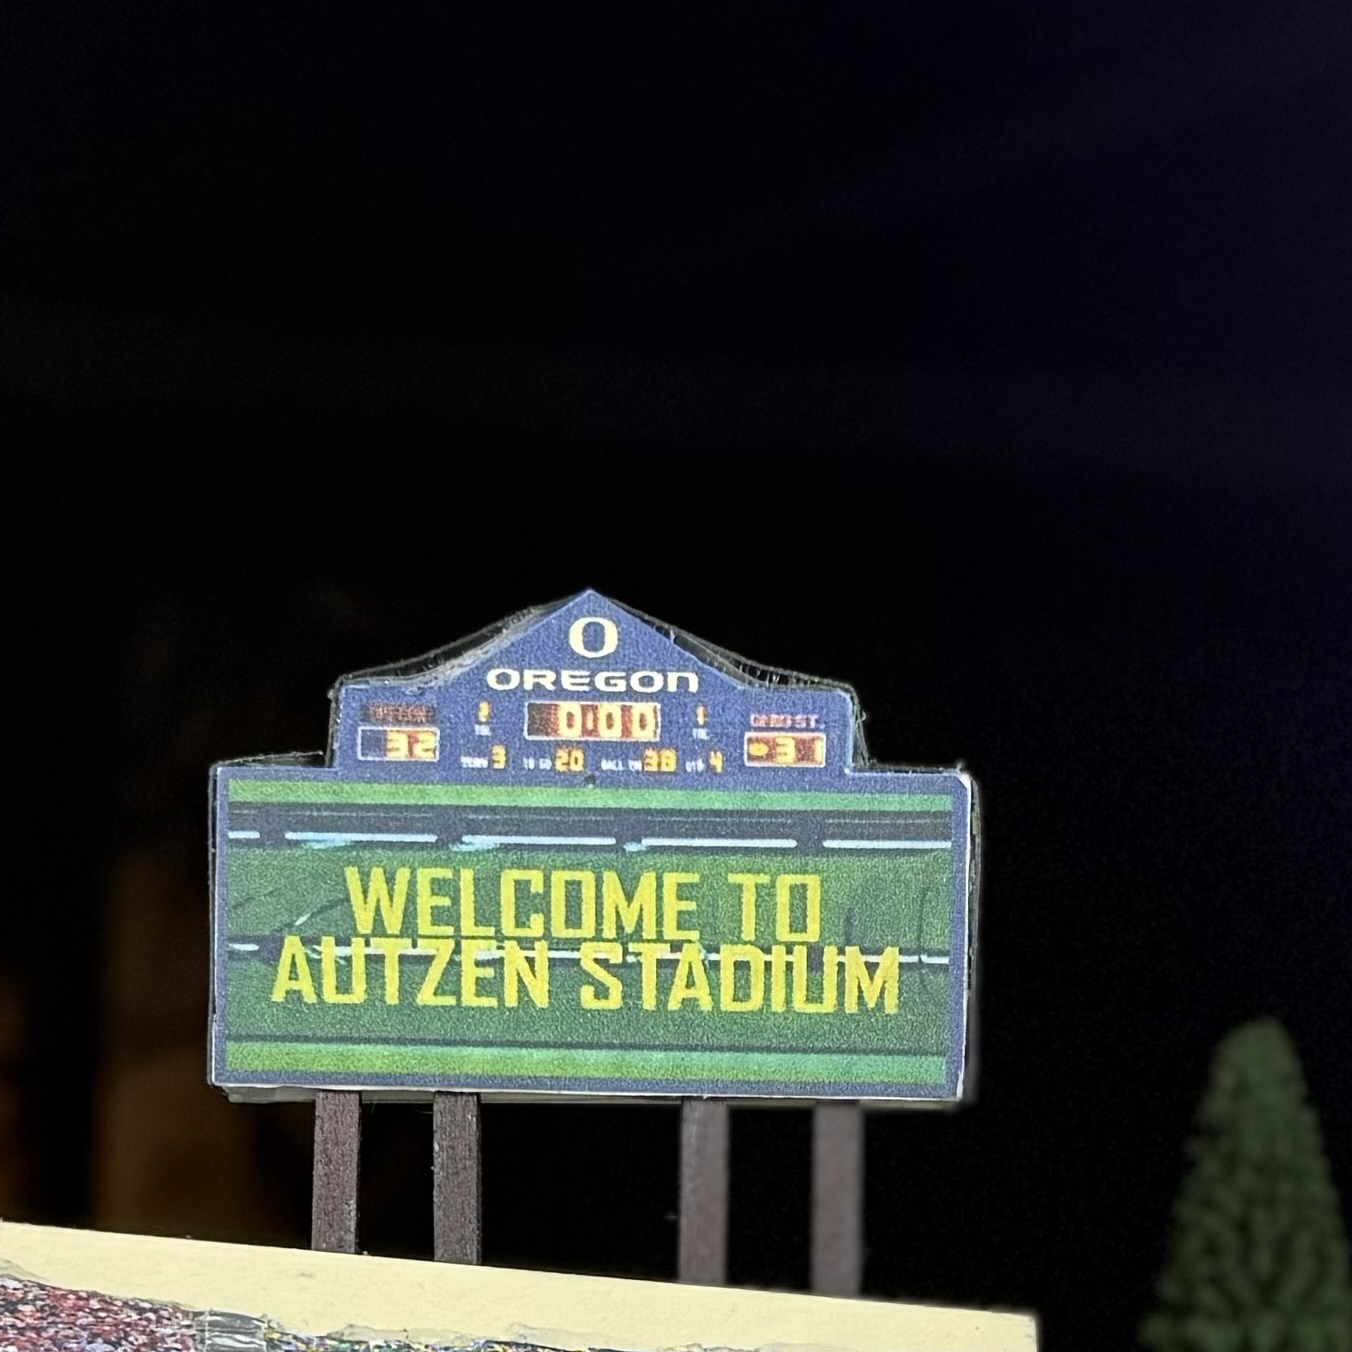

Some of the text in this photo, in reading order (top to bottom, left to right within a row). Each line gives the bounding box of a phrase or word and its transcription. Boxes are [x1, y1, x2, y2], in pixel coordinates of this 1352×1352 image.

[568, 617, 619, 658] O
[486, 669, 699, 693] OREGON
[492, 745, 507, 769] 3
[555, 747, 585, 772] 20
[344, 866, 820, 942] WELCOME TO
[271, 935, 899, 1014] AUTZEN STADIUM
